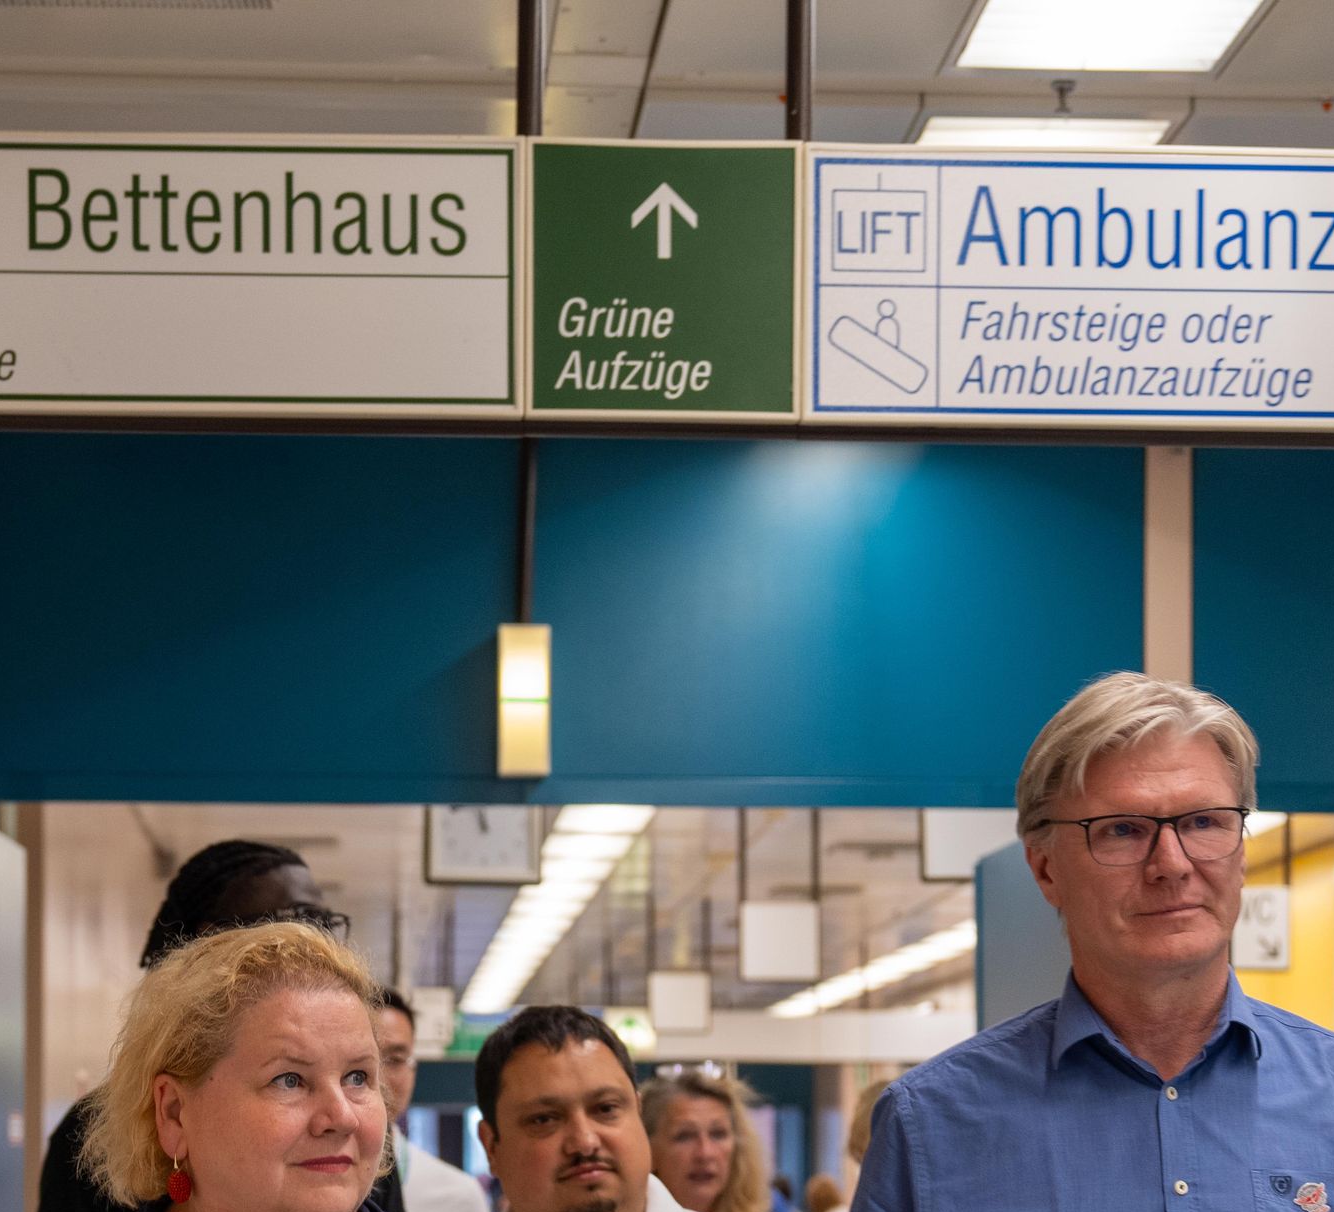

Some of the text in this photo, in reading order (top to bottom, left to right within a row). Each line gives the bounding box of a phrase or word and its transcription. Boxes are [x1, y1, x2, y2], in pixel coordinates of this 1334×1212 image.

[27, 167, 467, 257] Bettenhaus
[835, 210, 922, 256] LIFT
[557, 297, 674, 340] Grüne
[960, 301, 1273, 352] Fahrsteige oder
[553, 349, 712, 400] Aufzüge
[956, 355, 1314, 408] Ambulanzaufzüge
